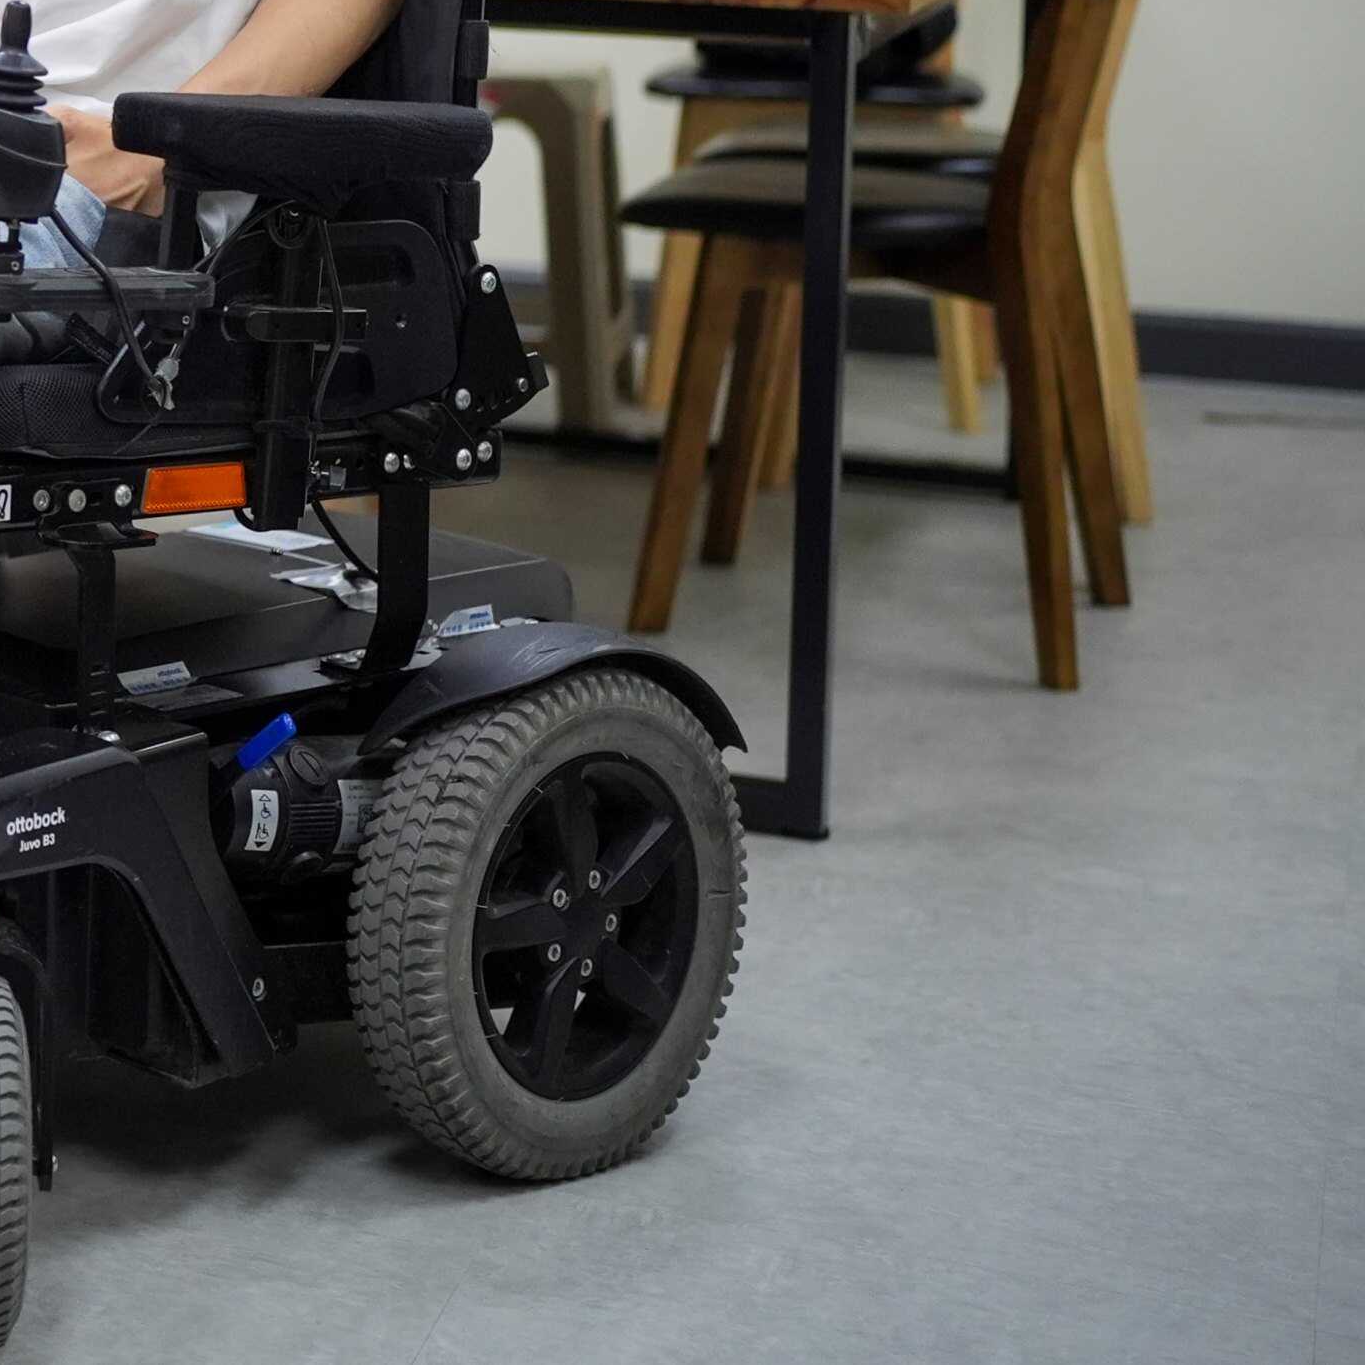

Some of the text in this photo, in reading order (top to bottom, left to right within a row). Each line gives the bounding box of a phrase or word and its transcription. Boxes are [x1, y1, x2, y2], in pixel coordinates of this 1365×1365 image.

[6, 806, 66, 836] ottobock
[19, 833, 56, 853] Juvo B3
